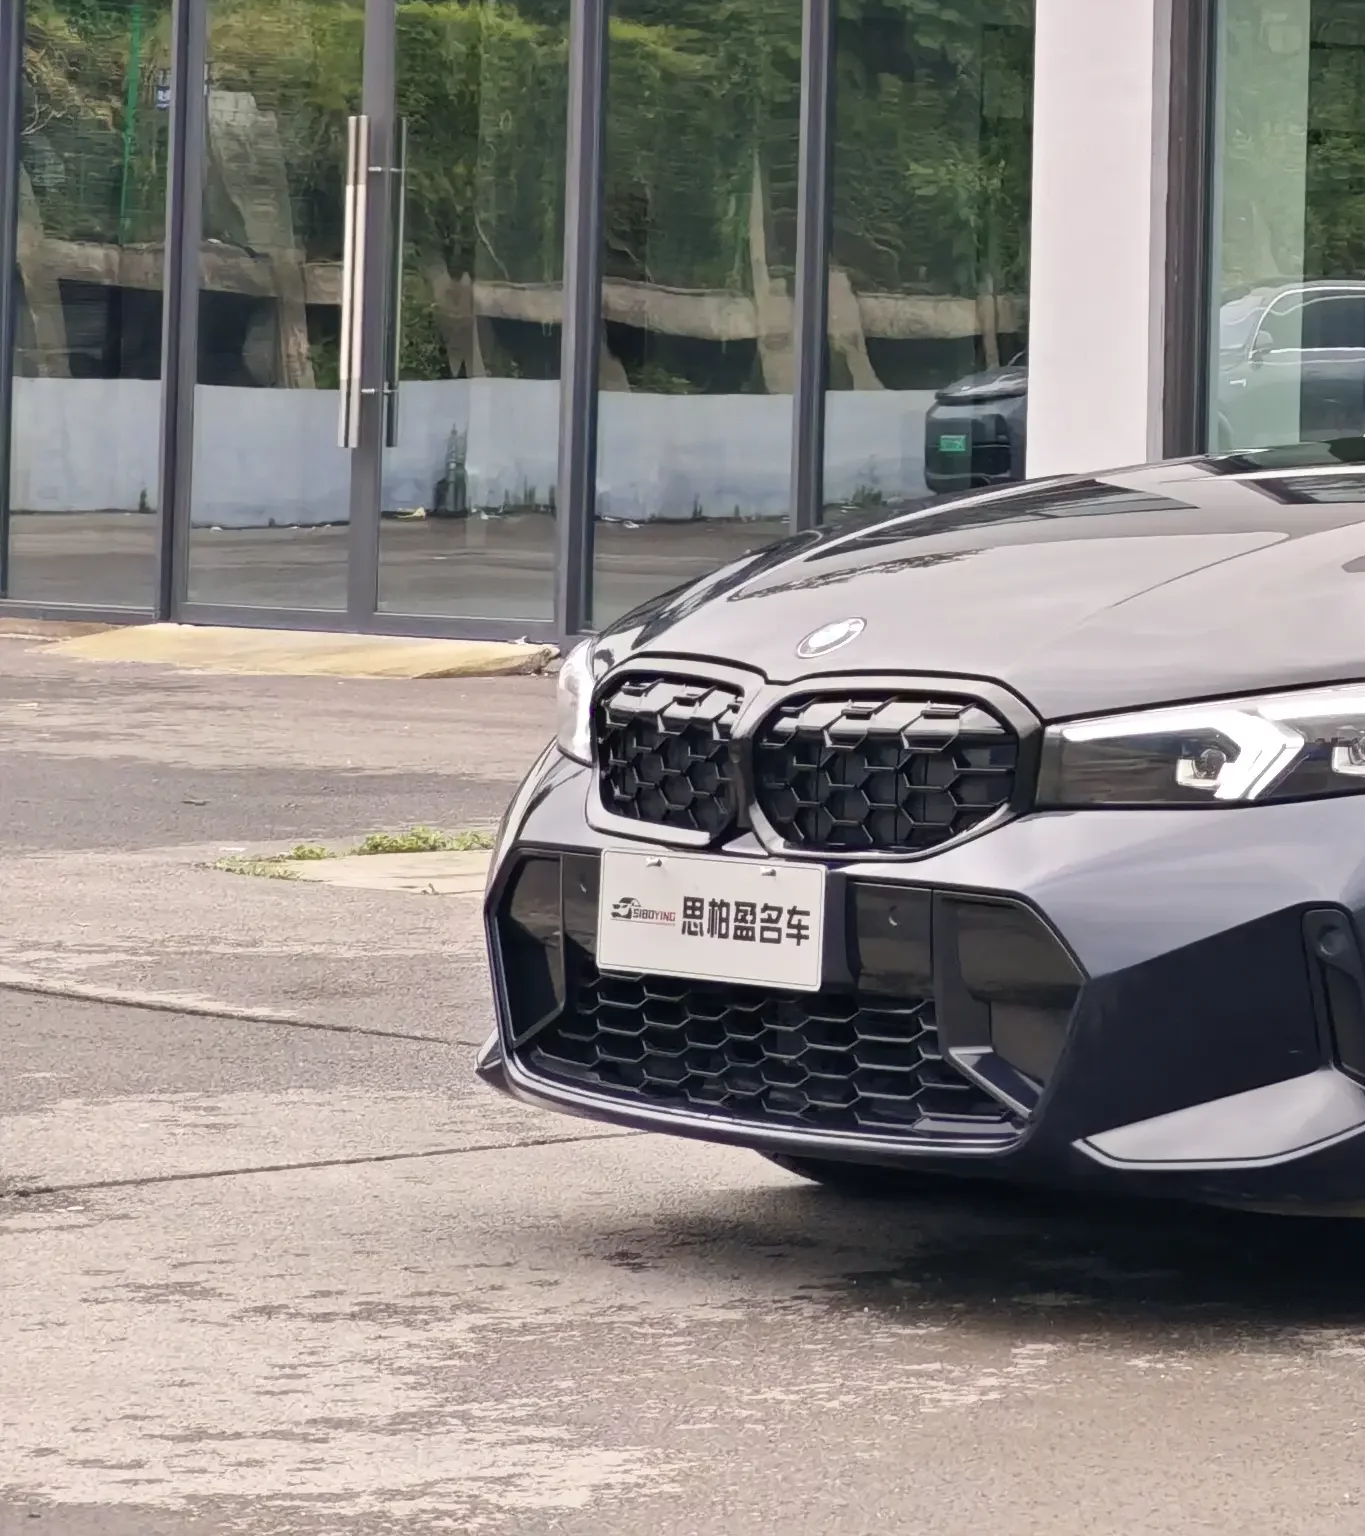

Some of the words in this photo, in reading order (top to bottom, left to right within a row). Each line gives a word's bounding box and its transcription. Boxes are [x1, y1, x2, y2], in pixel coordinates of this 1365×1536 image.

[632, 908, 676, 922] SIBOYING
[681, 895, 811, 946] 思柏盈名车
